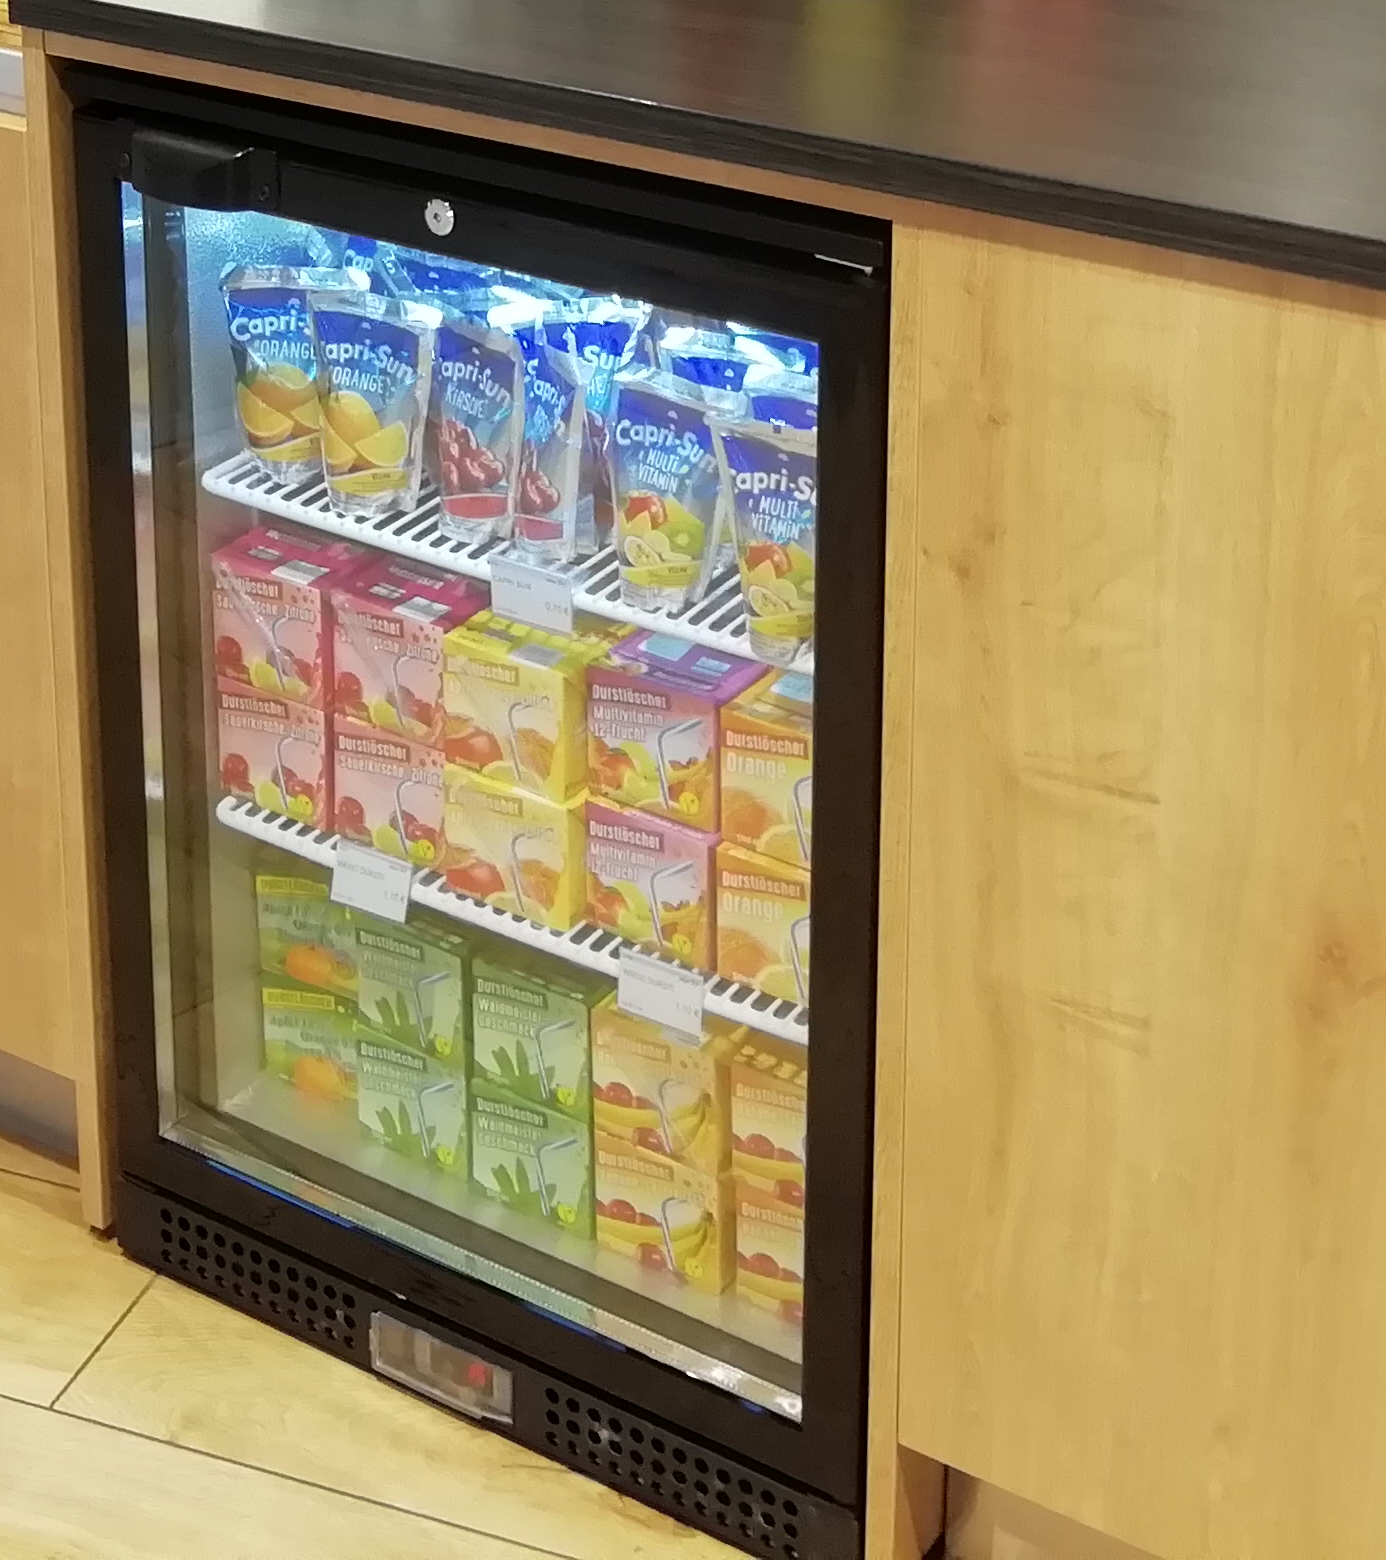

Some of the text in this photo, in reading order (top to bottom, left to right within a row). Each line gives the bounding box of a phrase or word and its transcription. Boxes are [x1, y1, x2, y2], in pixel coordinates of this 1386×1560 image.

[325, 340, 415, 384] apri-Sun
[333, 366, 385, 393] ORANGE
[441, 347, 512, 406] apri-Sun
[615, 417, 718, 470] Capri-Sun
[647, 448, 678, 471] MULTI
[638, 463, 679, 493] VITAMIN
[759, 495, 798, 520] MULTI
[222, 693, 286, 716] Durstlöscher
[592, 684, 667, 710] Durstlöscher
[594, 706, 664, 726] Multivitamin
[339, 735, 407, 760] Durstlöscher
[725, 730, 805, 756] Durstlöscher
[340, 758, 404, 777] Sauerkirsche
[726, 753, 787, 779] Orange
[589, 821, 661, 850] Durstlöscher
[590, 842, 656, 867] Multivitamin
[721, 871, 801, 898] Durstlöscher
[722, 893, 784, 918] Orange
[477, 979, 544, 1006] Durstlöscher
[477, 1097, 544, 1126] Durstlöscher
